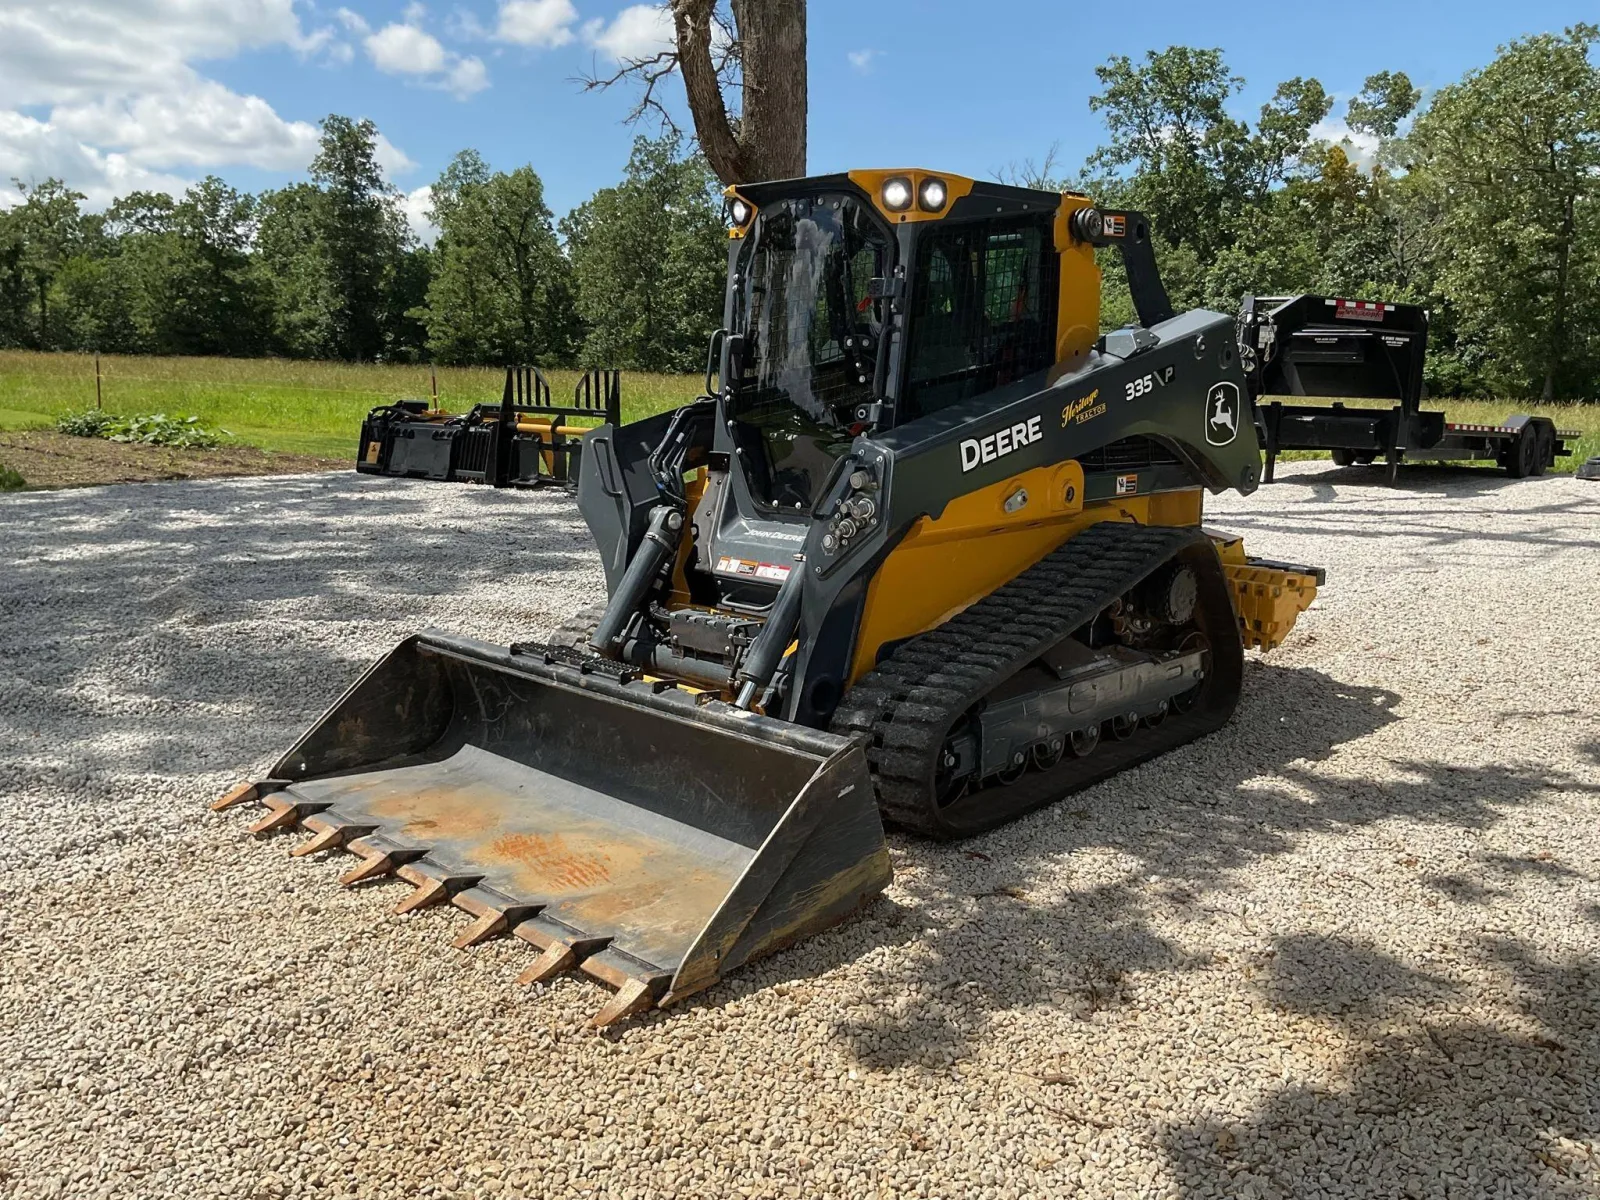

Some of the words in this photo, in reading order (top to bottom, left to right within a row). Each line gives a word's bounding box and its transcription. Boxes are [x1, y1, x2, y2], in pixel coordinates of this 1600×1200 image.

[1125, 374, 1153, 401] 335
[1061, 388, 1099, 428] Heritage
[1075, 403, 1107, 424] TRACTOR
[960, 415, 1043, 472] DEERE
[743, 529, 772, 538] JOHN
[770, 531, 807, 542] DEERE
